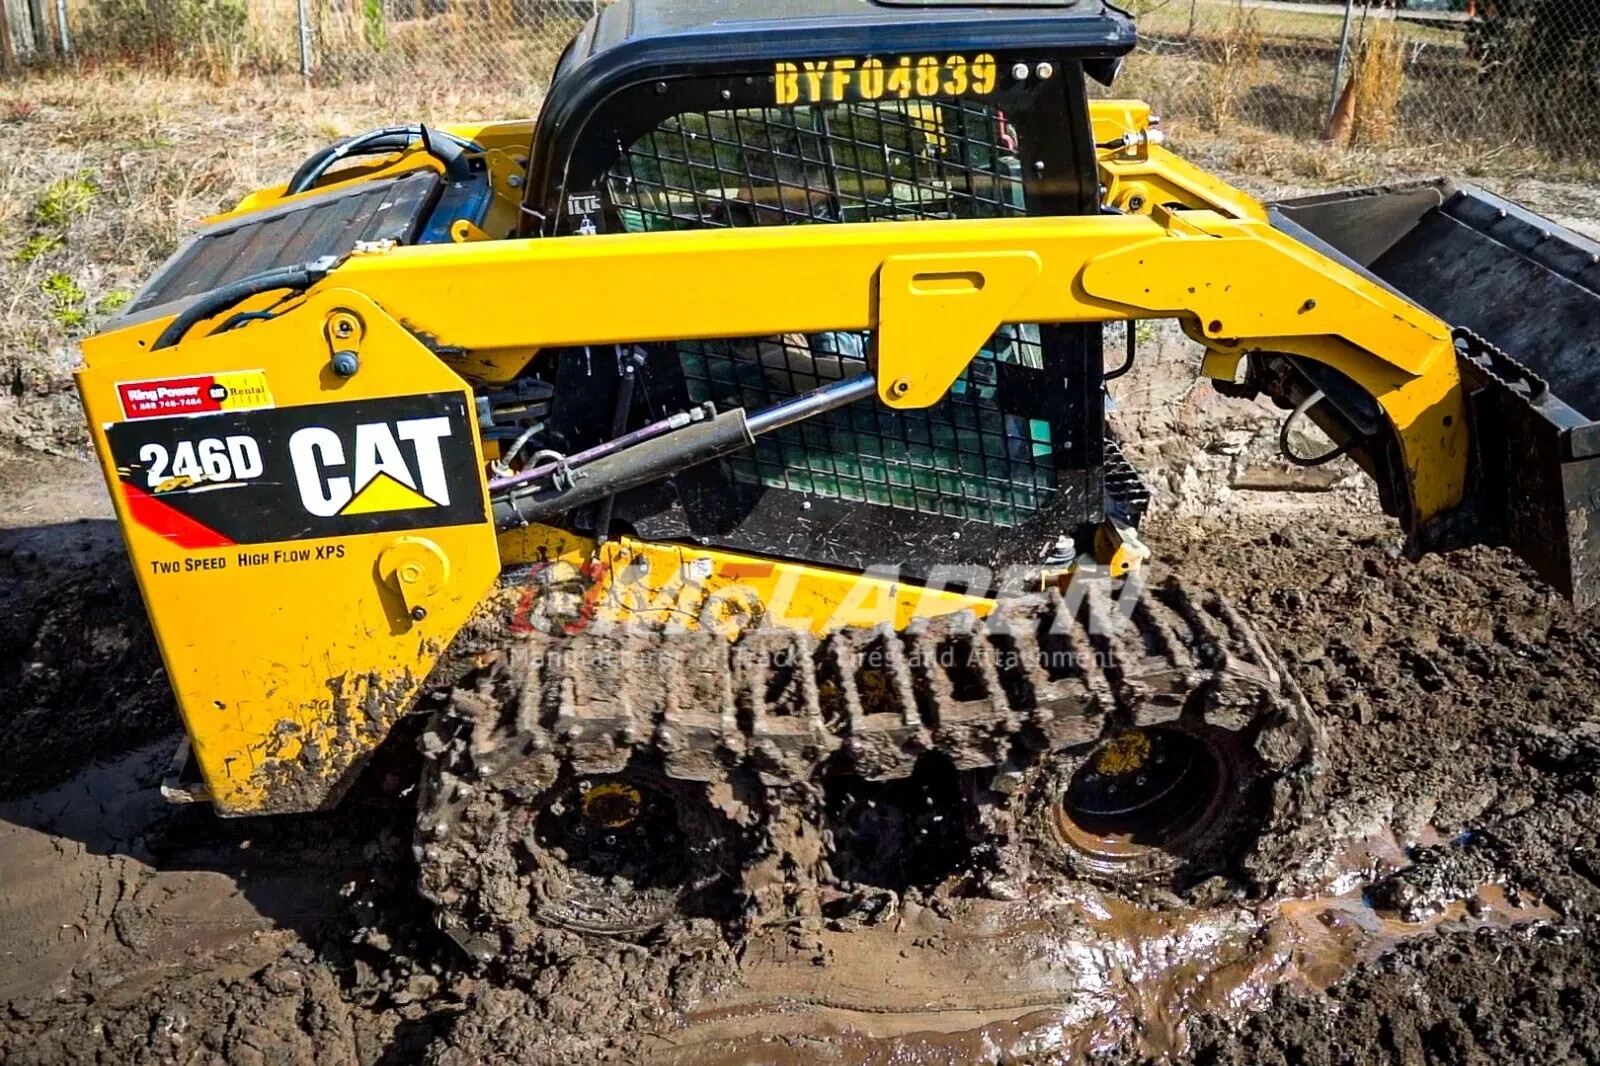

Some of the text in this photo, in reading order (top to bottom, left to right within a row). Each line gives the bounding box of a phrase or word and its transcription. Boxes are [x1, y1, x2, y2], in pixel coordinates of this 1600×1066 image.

[775, 53, 997, 105] BYF04839
[127, 386, 200, 402] Ring Power
[230, 385, 265, 396] Rental
[139, 435, 264, 487] 246D
[289, 416, 451, 517] CAT
[315, 544, 345, 560] XPS
